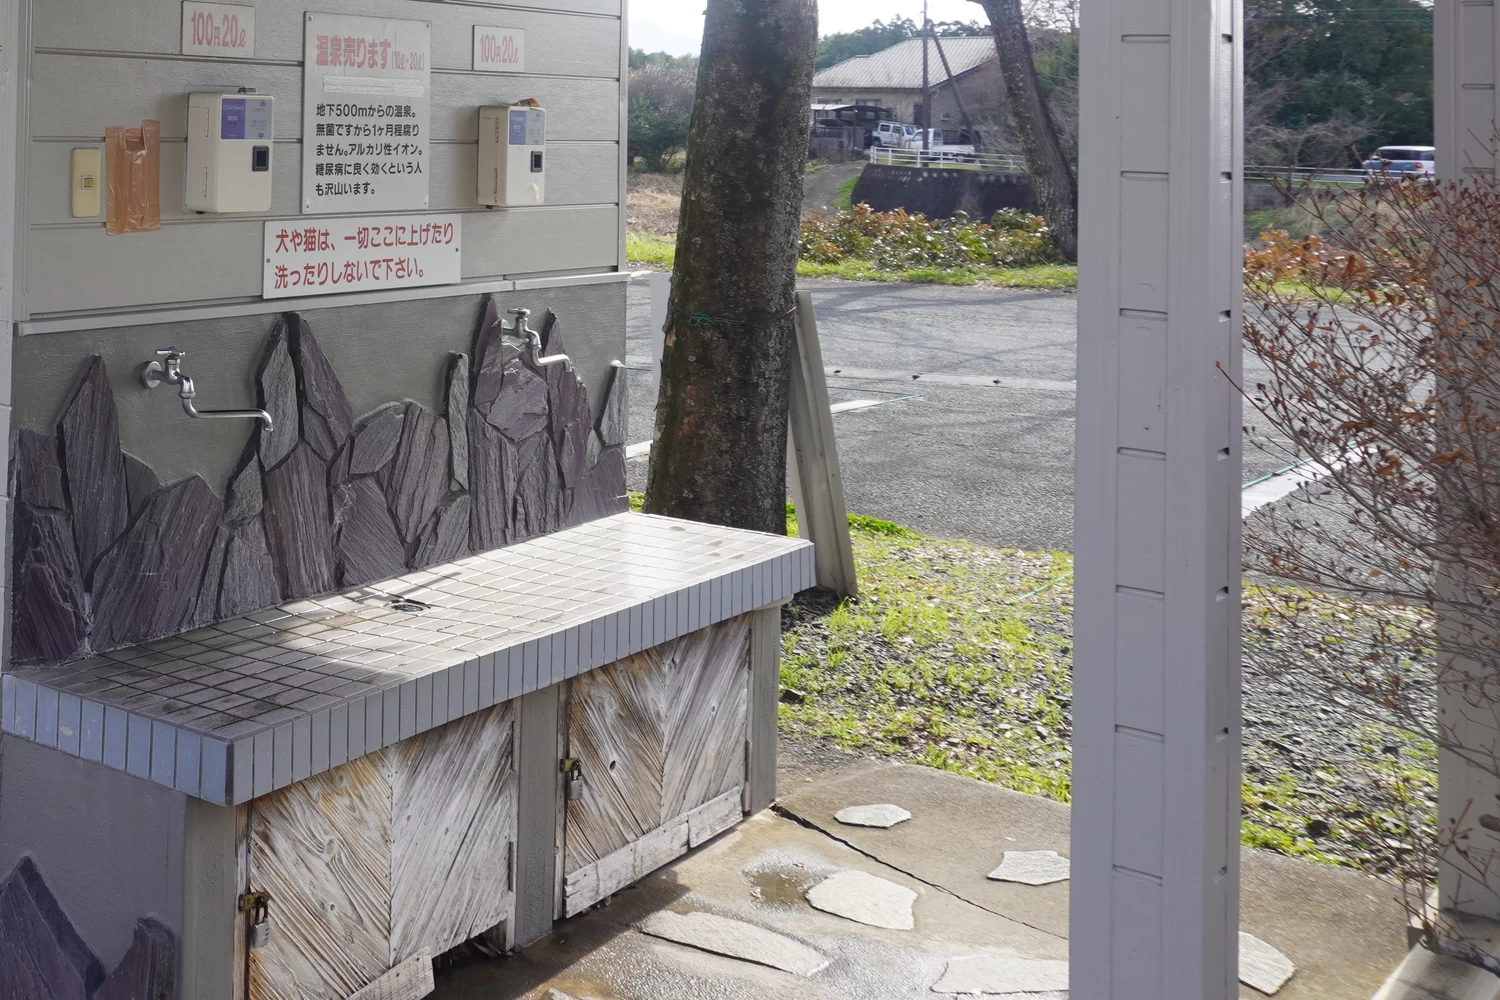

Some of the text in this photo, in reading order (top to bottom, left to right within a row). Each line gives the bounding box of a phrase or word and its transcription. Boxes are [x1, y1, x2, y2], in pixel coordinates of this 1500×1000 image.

[316, 103, 416, 118] 地下500mからの温泉。
[315, 161, 423, 176] 糖尿病に良く効くという人
[315, 182, 376, 196] も沢山います。
[274, 257, 424, 289] 洗ったりしないで下さい。
